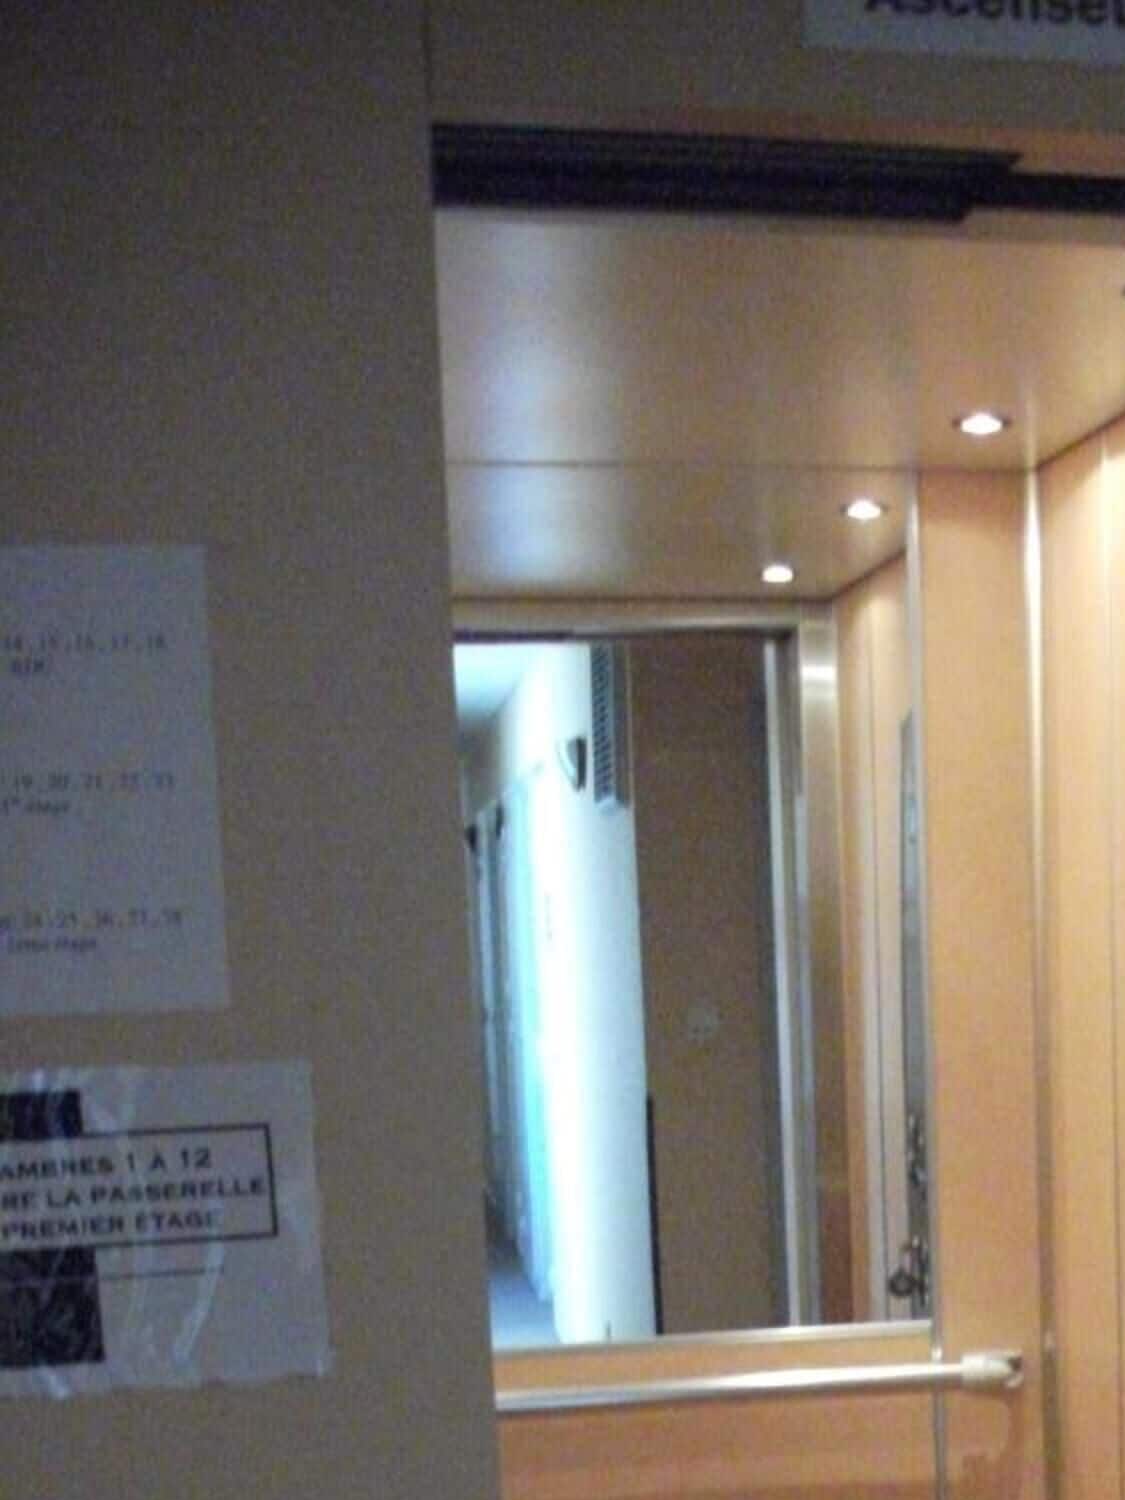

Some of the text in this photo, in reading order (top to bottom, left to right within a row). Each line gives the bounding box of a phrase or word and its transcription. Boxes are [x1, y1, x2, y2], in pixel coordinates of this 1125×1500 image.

[181, 1147, 213, 1169] 12
[47, 1185, 82, 1208] LA
[91, 1177, 265, 1205] PASSERELLE
